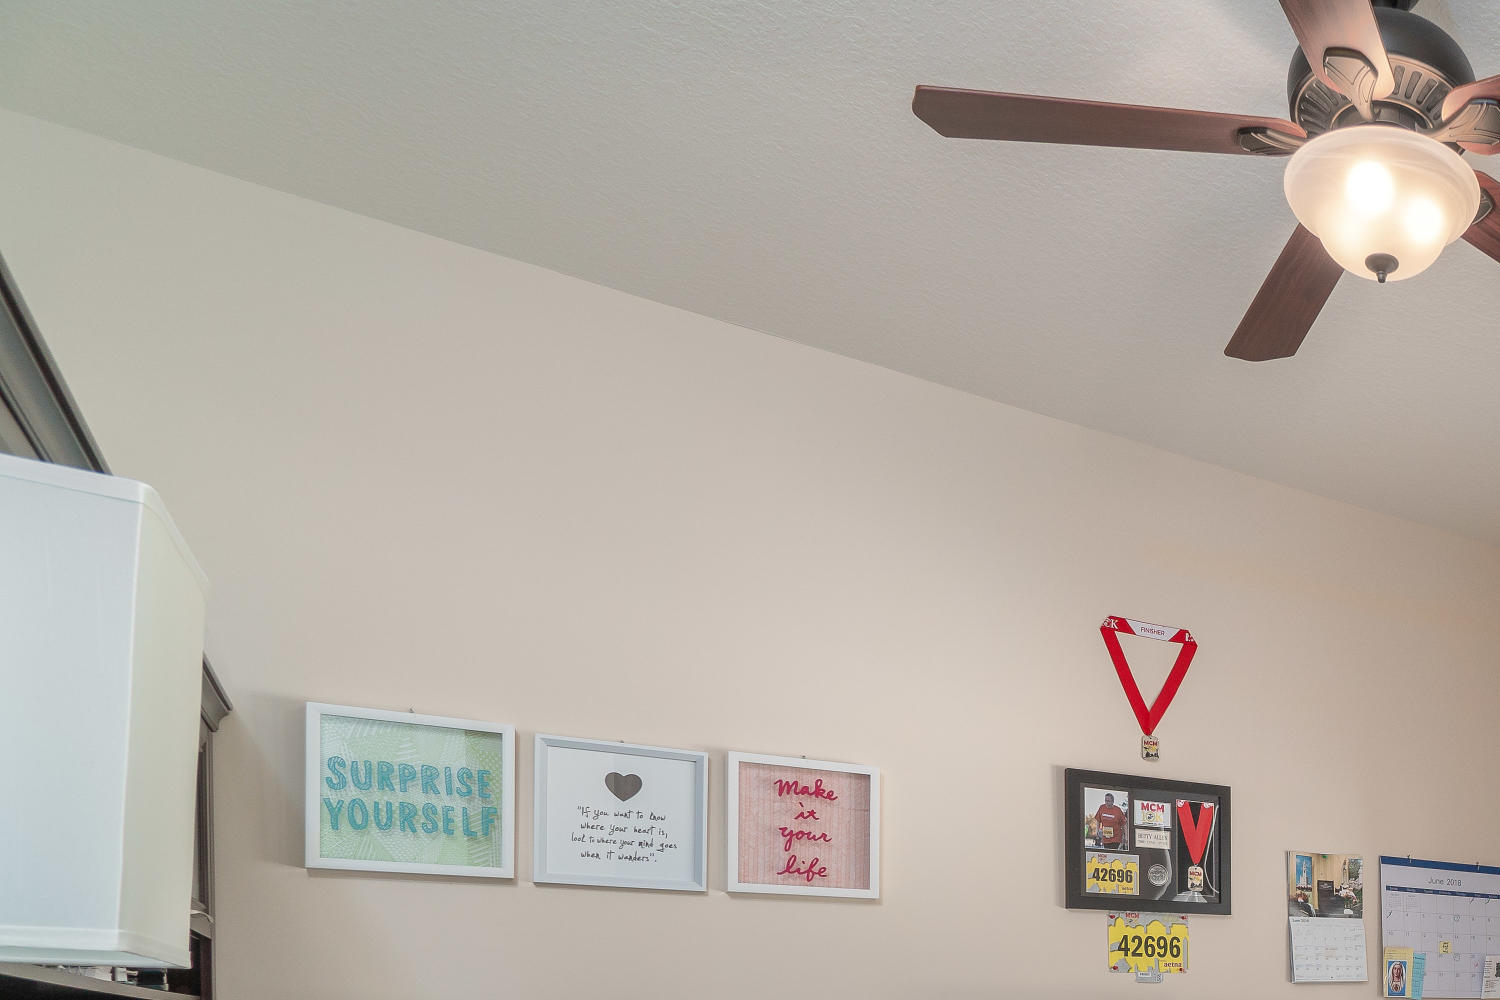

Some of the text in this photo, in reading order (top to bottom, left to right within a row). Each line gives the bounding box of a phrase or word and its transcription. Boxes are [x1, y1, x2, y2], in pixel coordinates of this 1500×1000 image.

[1140, 626, 1165, 636] FINISHER
[325, 756, 492, 799] SURPRISE
[774, 779, 838, 801] Make
[592, 809, 609, 820] you
[613, 809, 634, 819] want
[636, 809, 644, 819] to
[649, 812, 667, 821] know
[794, 802, 820, 820] it
[1141, 802, 1165, 813] MCM
[323, 798, 498, 837] YOURSELF
[580, 822, 606, 831] where
[608, 824, 628, 836] your
[633, 826, 656, 836] heart
[571, 831, 586, 843] look
[596, 836, 618, 844] where
[618, 839, 635, 849] your
[638, 838, 654, 849] mind
[656, 842, 678, 852] goes
[779, 826, 832, 852] your
[580, 849, 601, 860] when
[606, 849, 615, 860] it
[776, 854, 828, 882] life
[1092, 867, 1134, 884] 42696
[1428, 876, 1462, 887] June 2018
[1117, 934, 1181, 959] 42696
